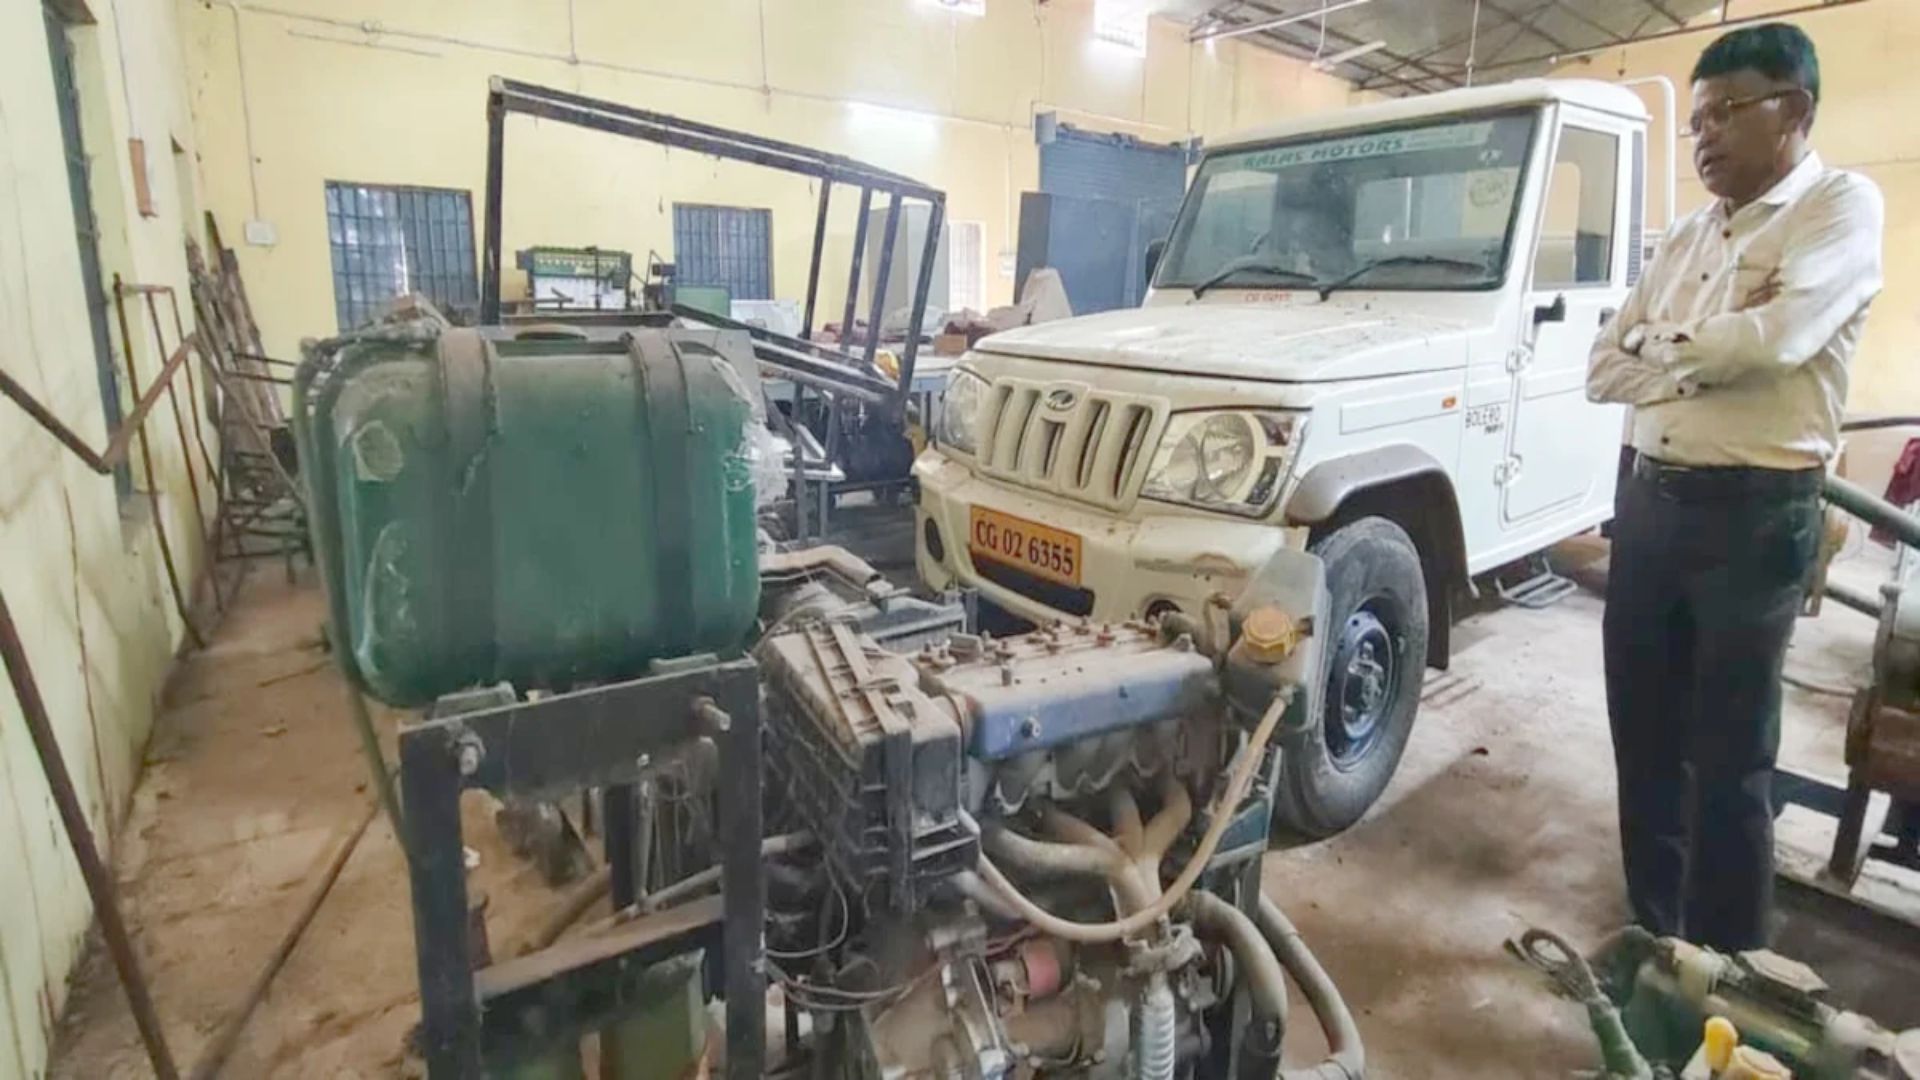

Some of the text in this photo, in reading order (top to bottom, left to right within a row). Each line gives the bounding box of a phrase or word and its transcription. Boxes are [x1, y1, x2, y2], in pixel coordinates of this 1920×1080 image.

[1311, 137, 1403, 160] MOTORS
[1465, 406, 1502, 429] BOLERO
[976, 520, 1074, 576] CG 02 6355
